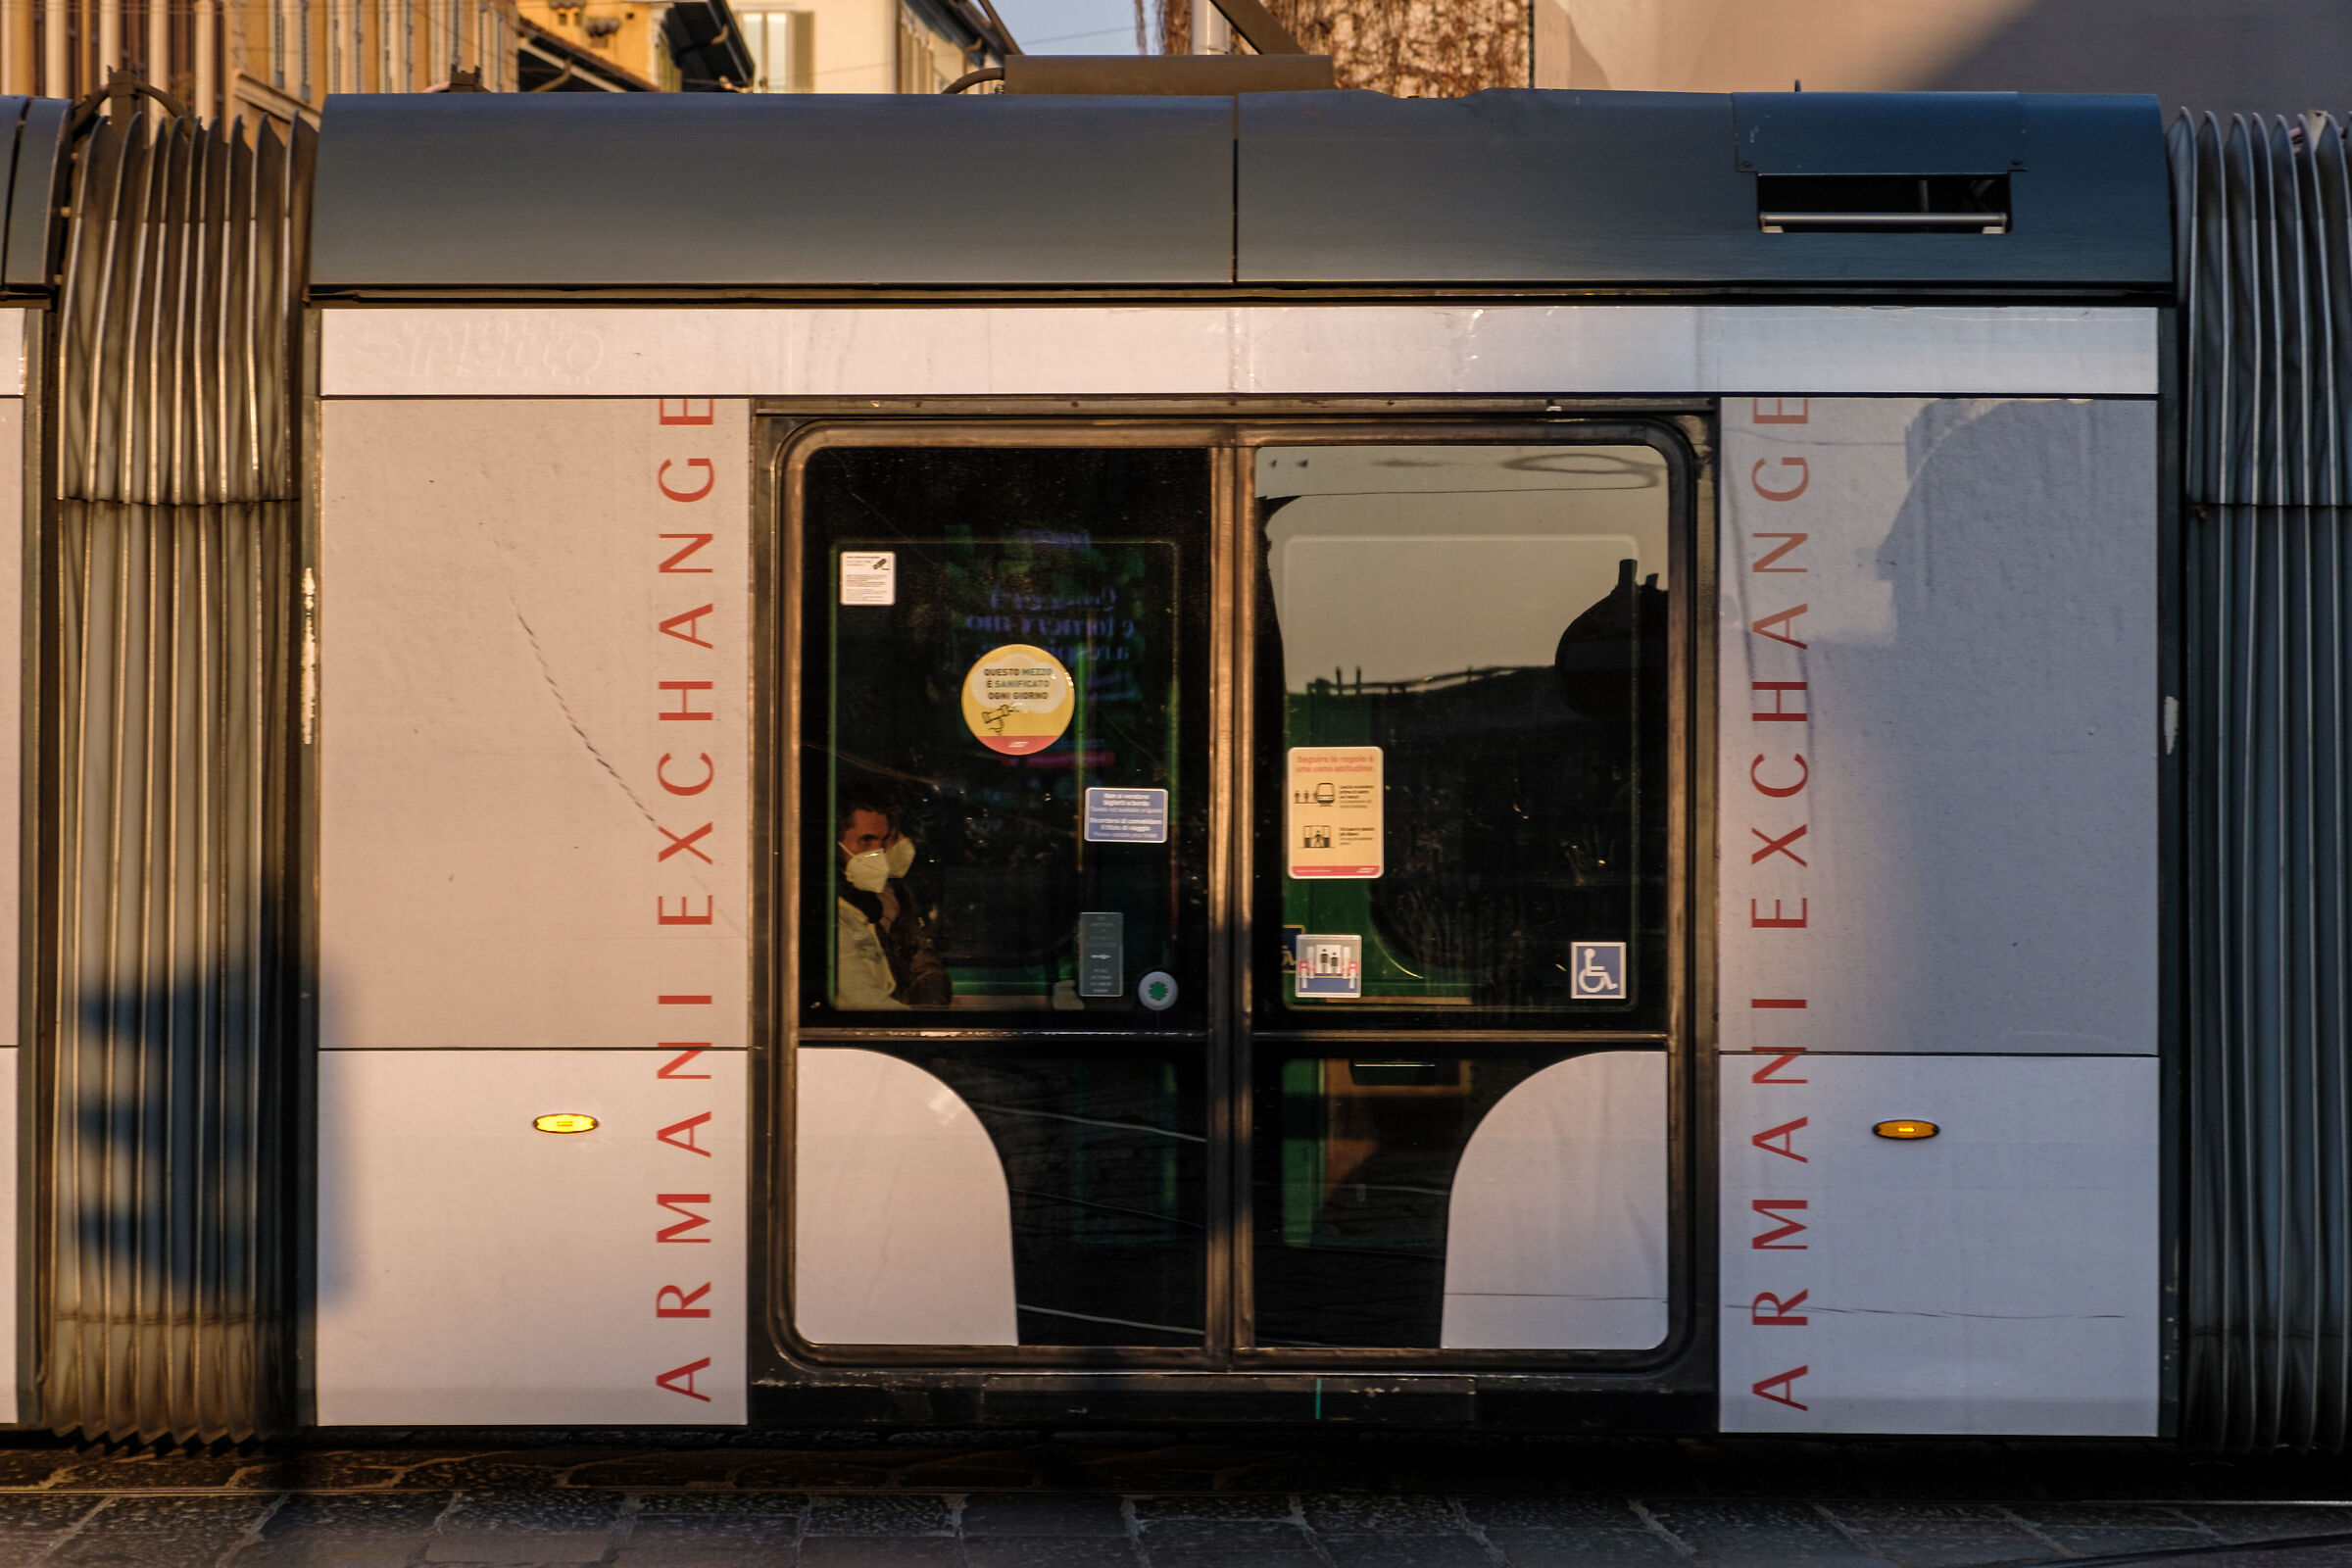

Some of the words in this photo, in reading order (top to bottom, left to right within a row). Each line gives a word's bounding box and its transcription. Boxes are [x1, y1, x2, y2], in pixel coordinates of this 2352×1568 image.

[657, 398, 715, 926] EXCHANGE
[984, 667, 1020, 676] QUESTO
[1022, 667, 1053, 676] MEZZO
[987, 691, 1010, 700] OGNI
[1012, 691, 1049, 700] GIORNO
[995, 679, 1051, 688] SANIFICATO
[1750, 398, 1810, 928] EXCHANGE
[655, 995, 713, 1402] ARMANI
[1750, 997, 1809, 1411] ARMANI
